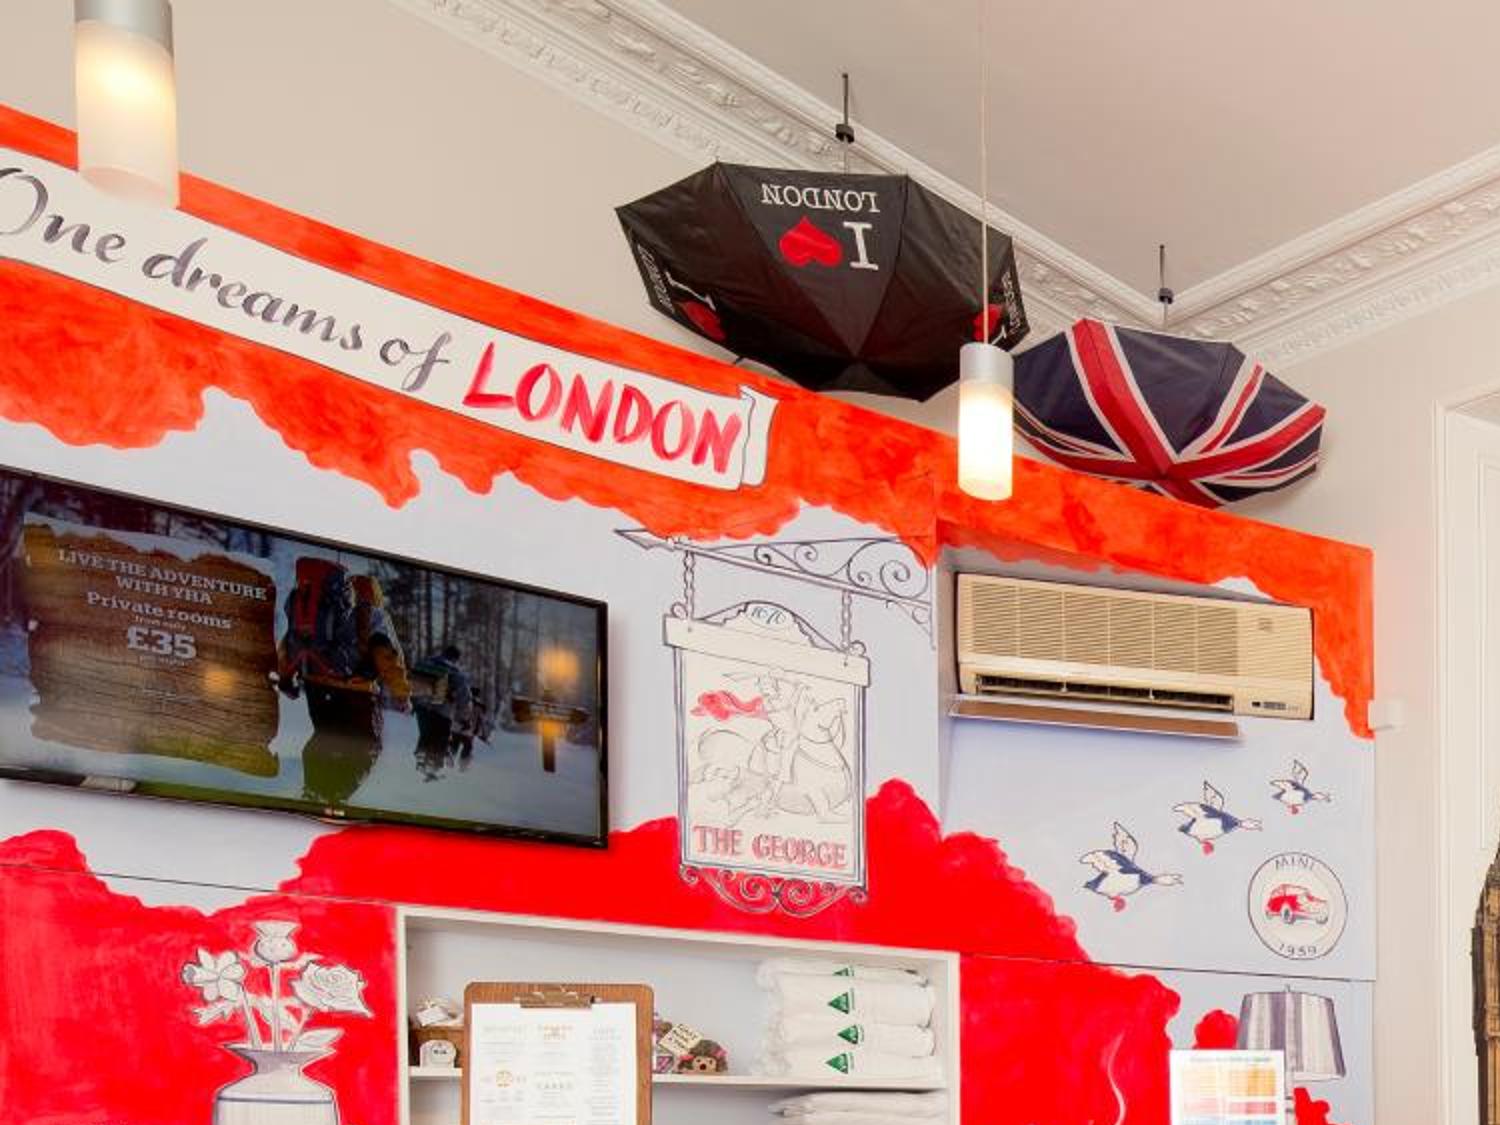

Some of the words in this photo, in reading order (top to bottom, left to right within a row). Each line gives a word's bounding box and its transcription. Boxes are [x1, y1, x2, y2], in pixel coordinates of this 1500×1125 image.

[761, 183, 881, 213] LONDON
[843, 221, 879, 271] I
[0, 166, 127, 264] One
[142, 237, 364, 350] dreams
[379, 330, 450, 393] of
[462, 340, 744, 474] LONDON
[58, 549, 104, 570] LIVE
[104, 557, 147, 578] THE
[149, 566, 268, 601] ADVENTURE
[115, 575, 168, 598] WITH
[168, 587, 213, 605] YHA
[87, 590, 165, 618] Private
[166, 609, 234, 630] rooms
[126, 624, 198, 660] £35
[692, 825, 743, 858] THE
[751, 832, 849, 869] GEORGE
[1274, 855, 1317, 872] MINI
